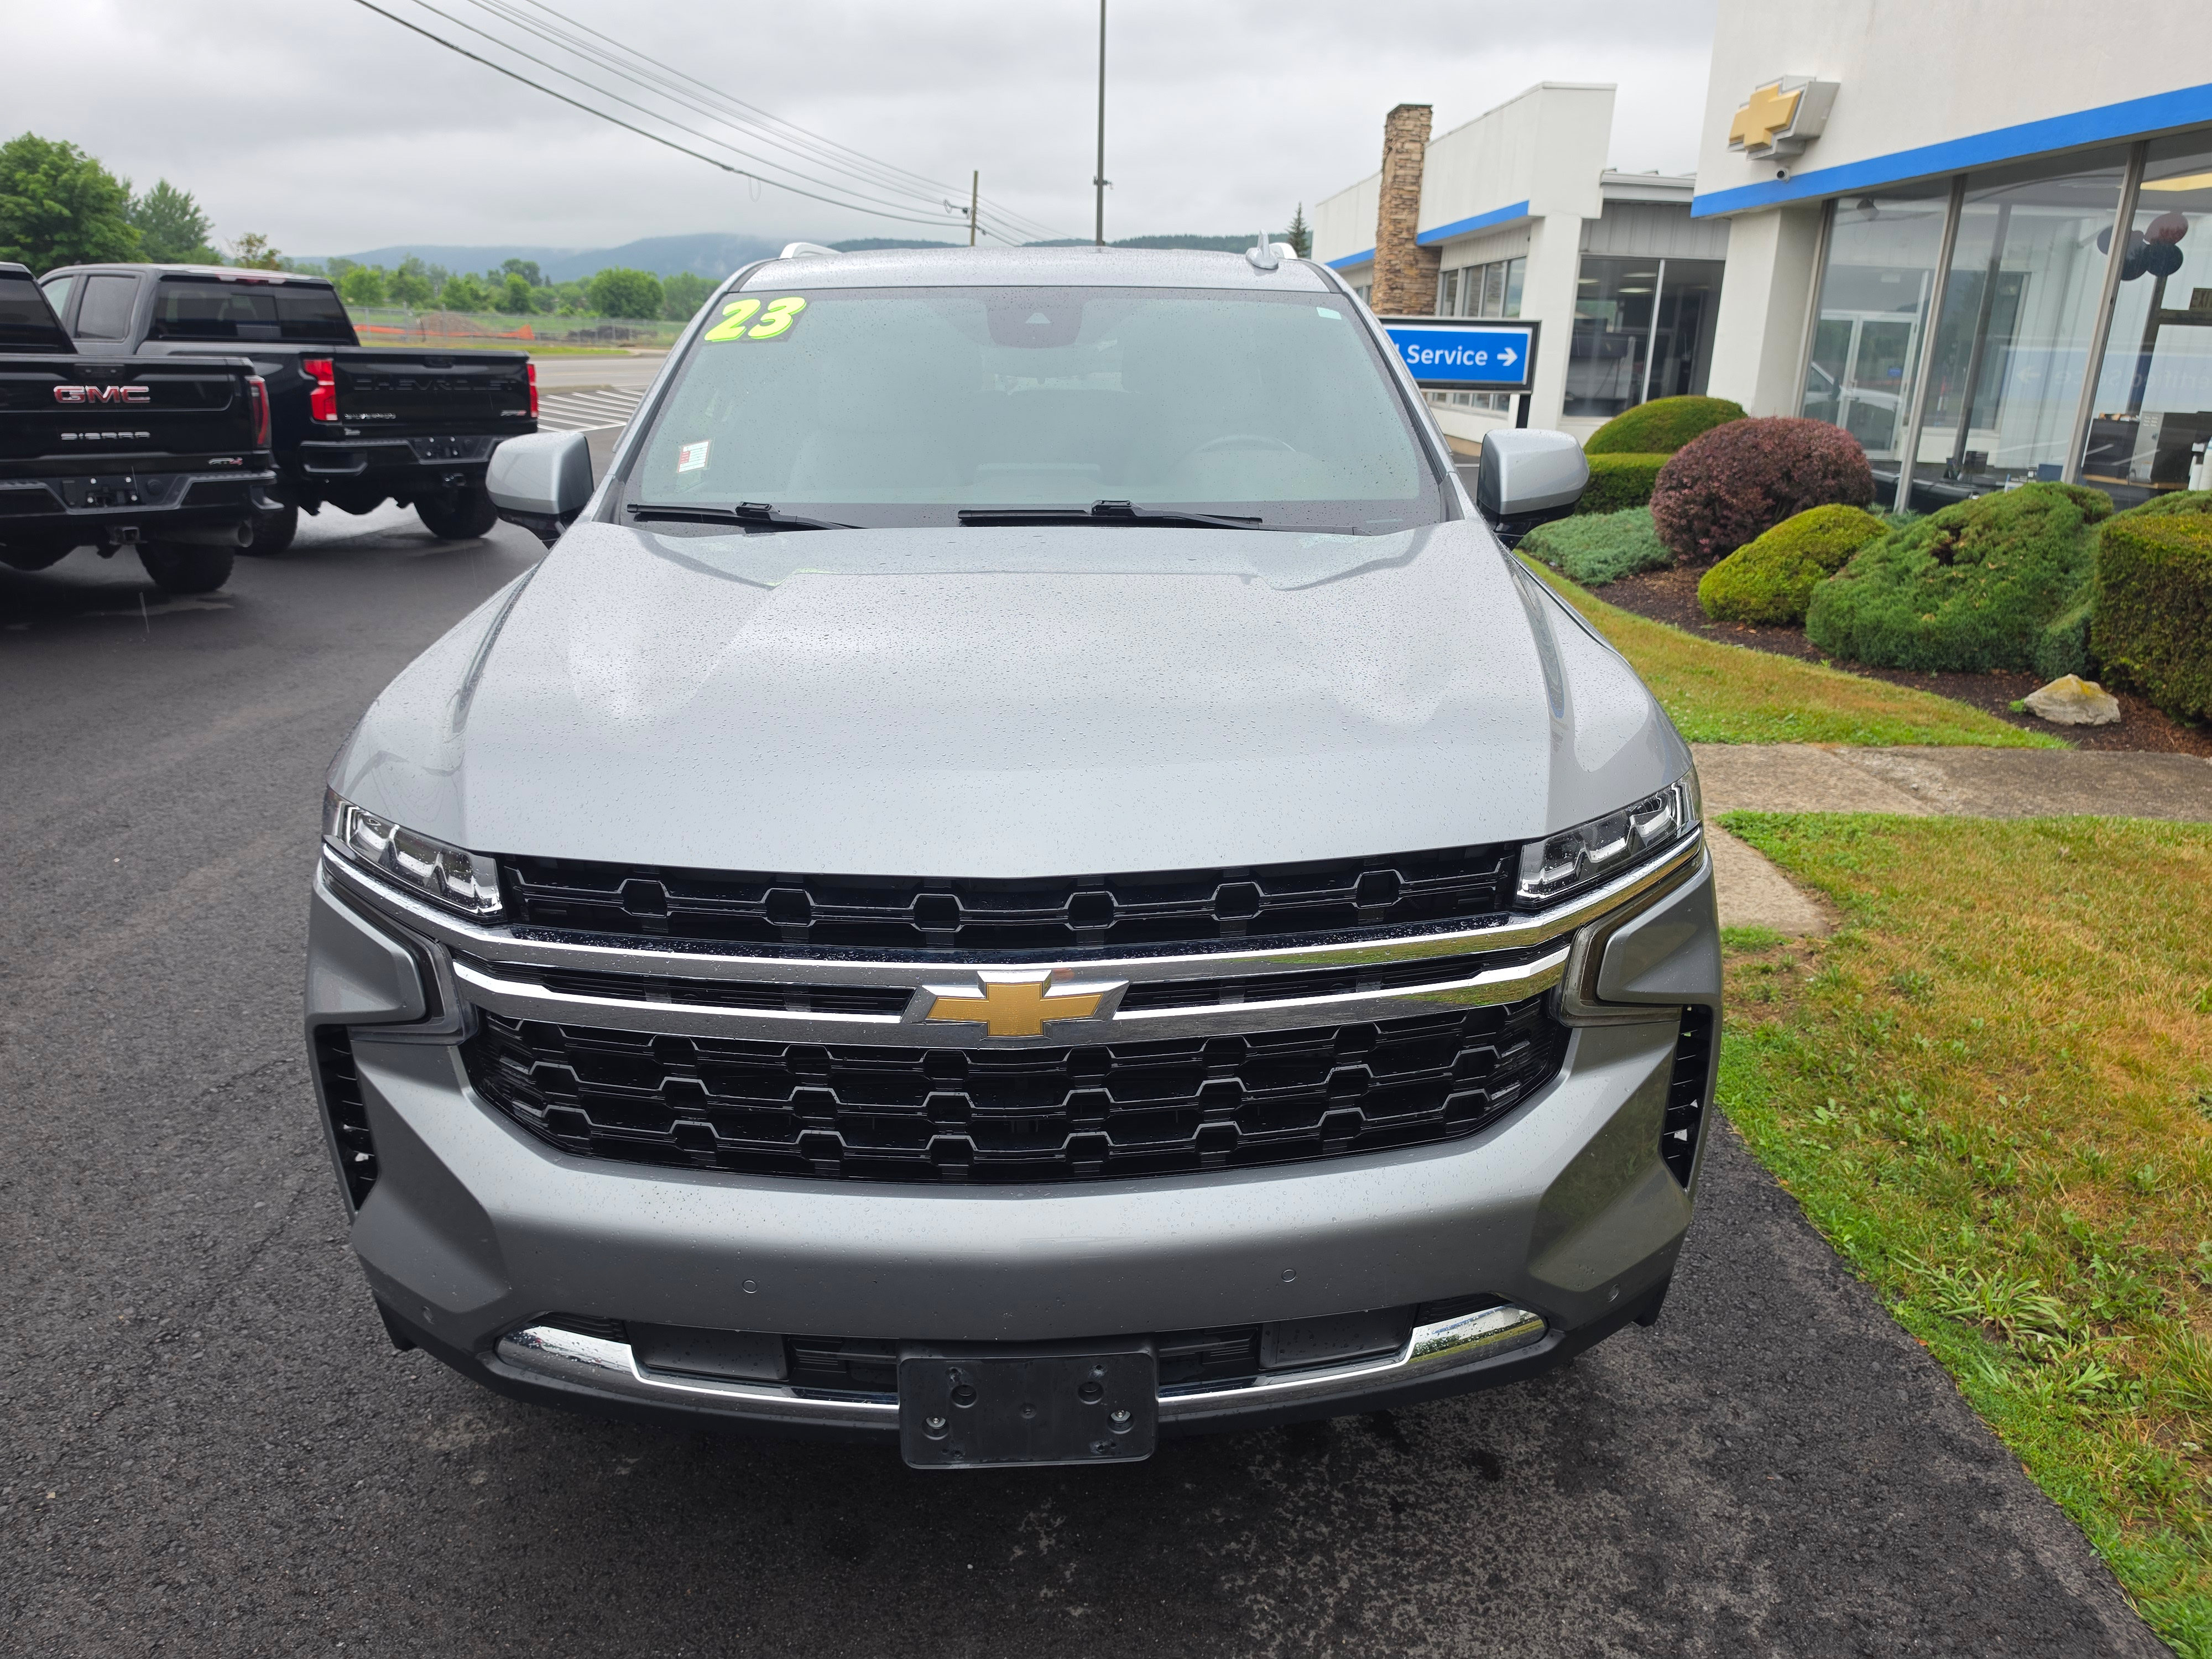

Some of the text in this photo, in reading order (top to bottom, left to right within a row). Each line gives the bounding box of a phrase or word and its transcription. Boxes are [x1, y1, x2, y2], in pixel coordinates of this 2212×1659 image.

[704, 297, 807, 342] 23
[1406, 343, 1488, 366] Service
[54, 385, 150, 403] GMC
